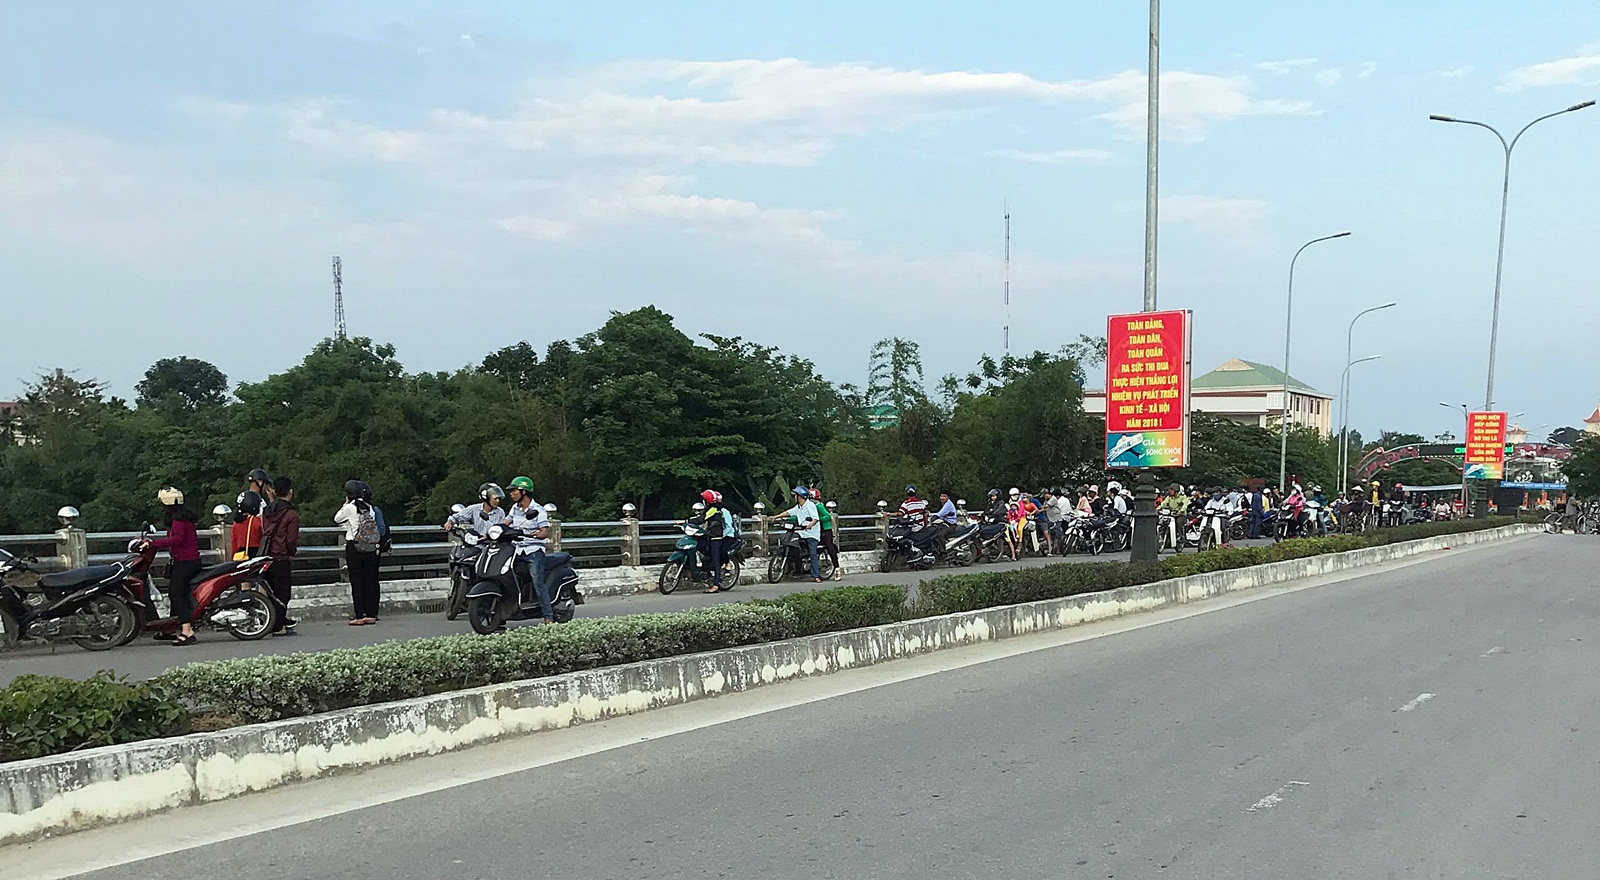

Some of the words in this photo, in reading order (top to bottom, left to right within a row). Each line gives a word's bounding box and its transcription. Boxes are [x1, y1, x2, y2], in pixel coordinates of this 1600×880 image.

[1127, 319, 1144, 331] TOÀN
[1129, 333, 1146, 345] TOÀN
[1127, 347, 1145, 359] TOÀN
[1145, 346, 1163, 359] QUÂN
[1121, 364, 1130, 373] RA
[1131, 361, 1144, 373] SỨC
[1145, 362, 1155, 371] THI
[1142, 388, 1159, 400] PHÁT
[1119, 405, 1135, 415] KINH
[1136, 402, 1144, 414] TẾ
[1142, 418, 1158, 428] 2018
[1142, 438, 1156, 447] GIÁ
